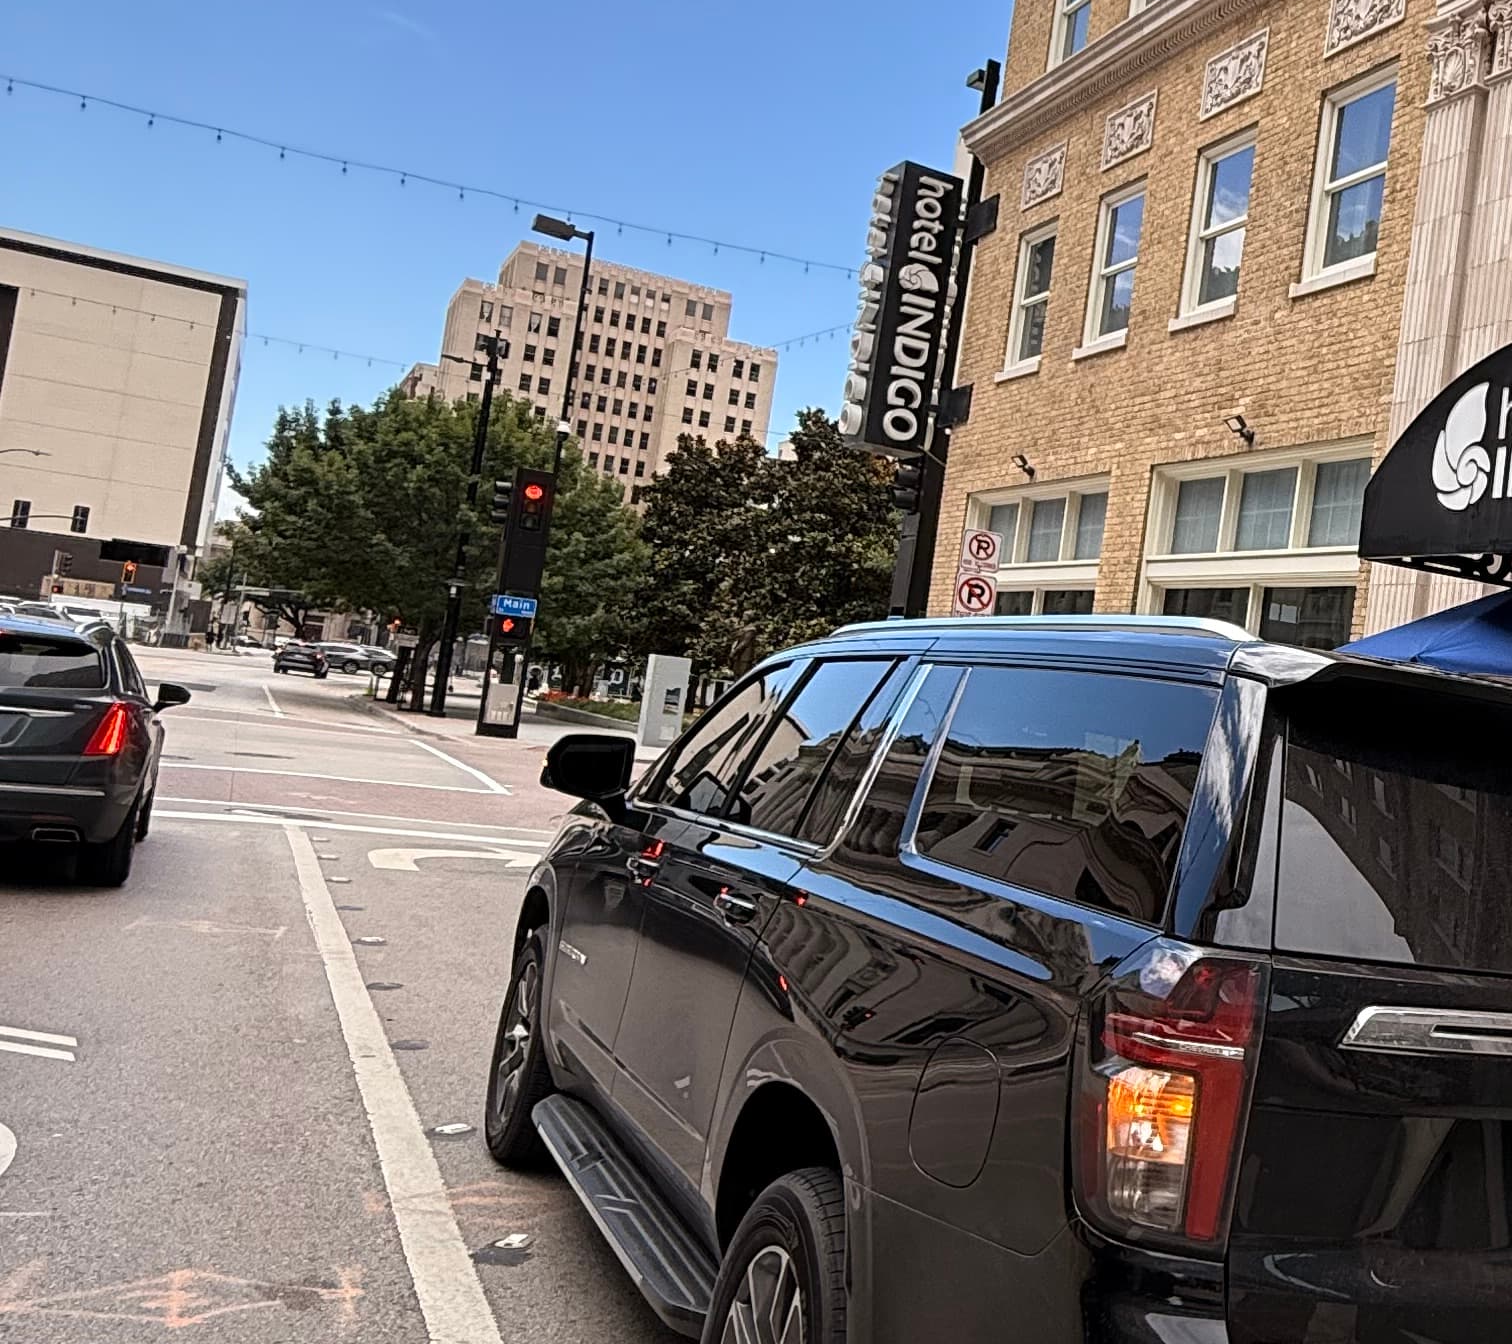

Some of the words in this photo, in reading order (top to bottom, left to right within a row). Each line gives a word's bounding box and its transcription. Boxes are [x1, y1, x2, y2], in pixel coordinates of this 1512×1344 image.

[907, 174, 954, 265] hotel
[882, 292, 936, 442] INDIGO
[503, 598, 530, 611] Main
